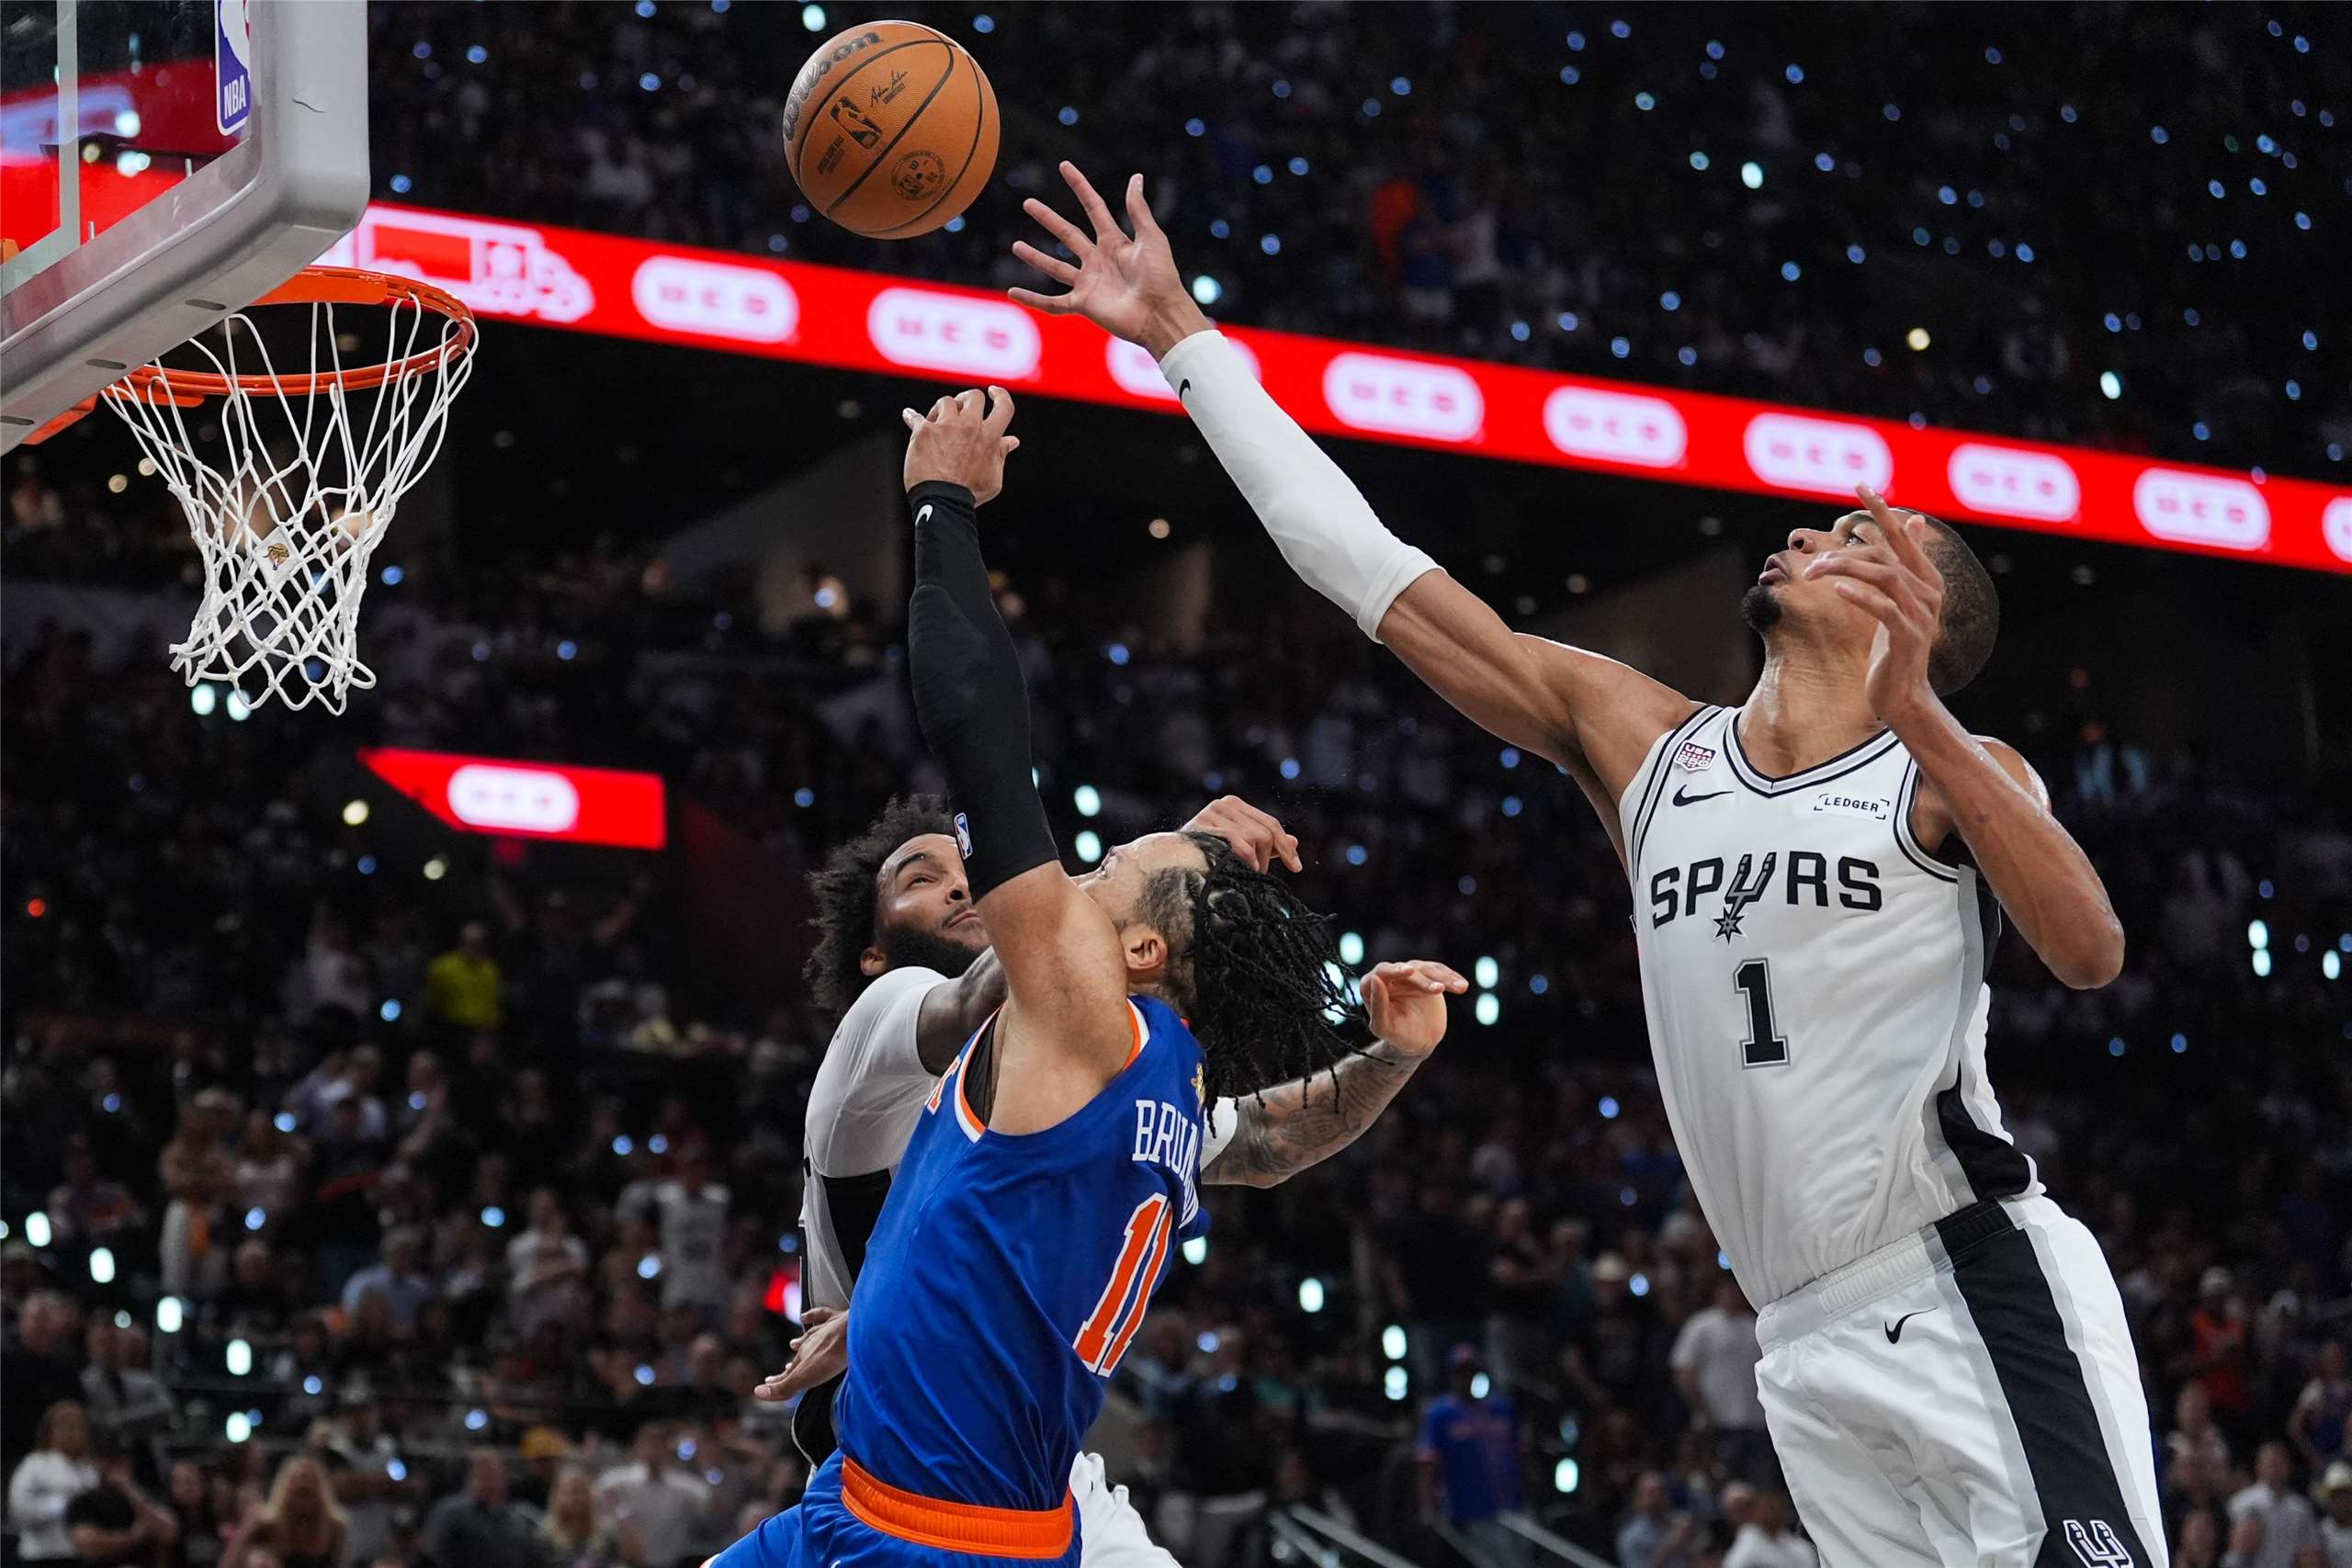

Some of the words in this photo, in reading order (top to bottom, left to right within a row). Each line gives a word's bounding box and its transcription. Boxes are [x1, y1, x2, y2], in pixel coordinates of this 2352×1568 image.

[223, 74, 246, 119] NBA
[1678, 754, 1709, 767] 250
[1685, 744, 1713, 757] USA
[1824, 796, 1880, 813] LEDGER
[1651, 851, 1883, 944] SPURS
[1733, 957, 1791, 1070] 1
[1073, 1192, 1174, 1378] 11
